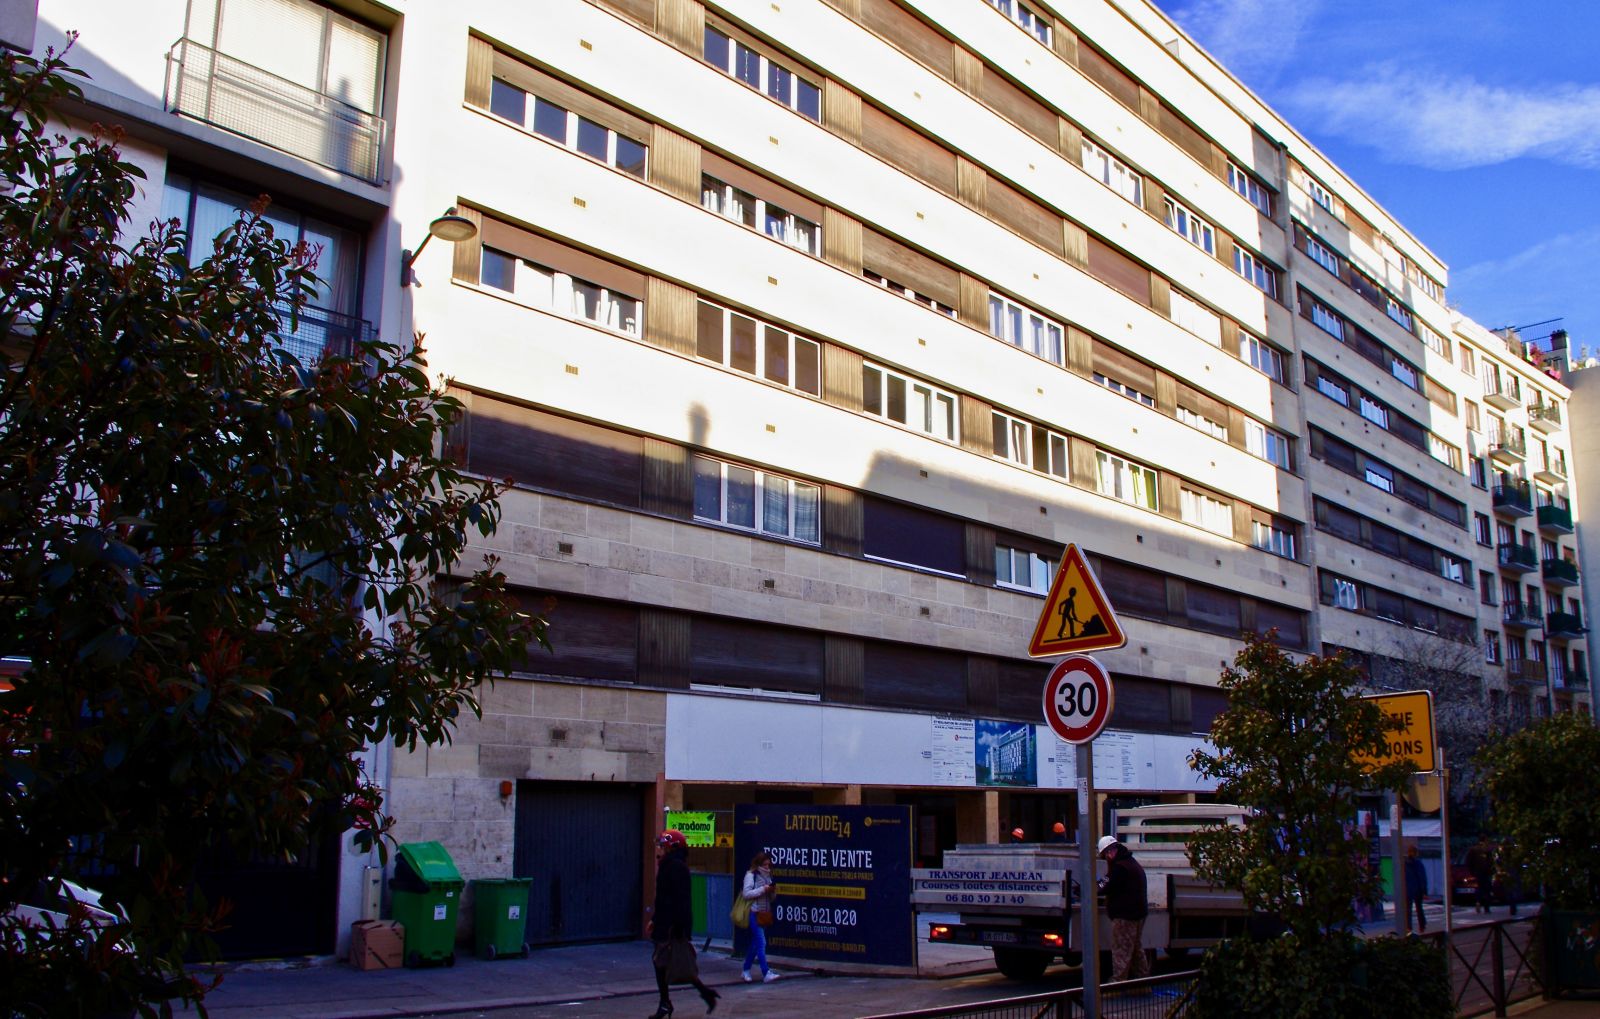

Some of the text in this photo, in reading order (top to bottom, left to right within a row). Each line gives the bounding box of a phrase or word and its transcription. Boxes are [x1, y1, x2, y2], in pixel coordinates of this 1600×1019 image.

[1057, 682, 1096, 717] 30
[1355, 741, 1424, 758] CAIONS
[812, 848, 827, 867] DE
[831, 849, 873, 869] VENTE
[928, 870, 1043, 881] TRANSPORT JEANJEAN
[921, 881, 1048, 892] Courses toutes distances
[945, 894, 1024, 904] 06 80 30 21 40
[776, 905, 857, 926] 0 805 021 020
